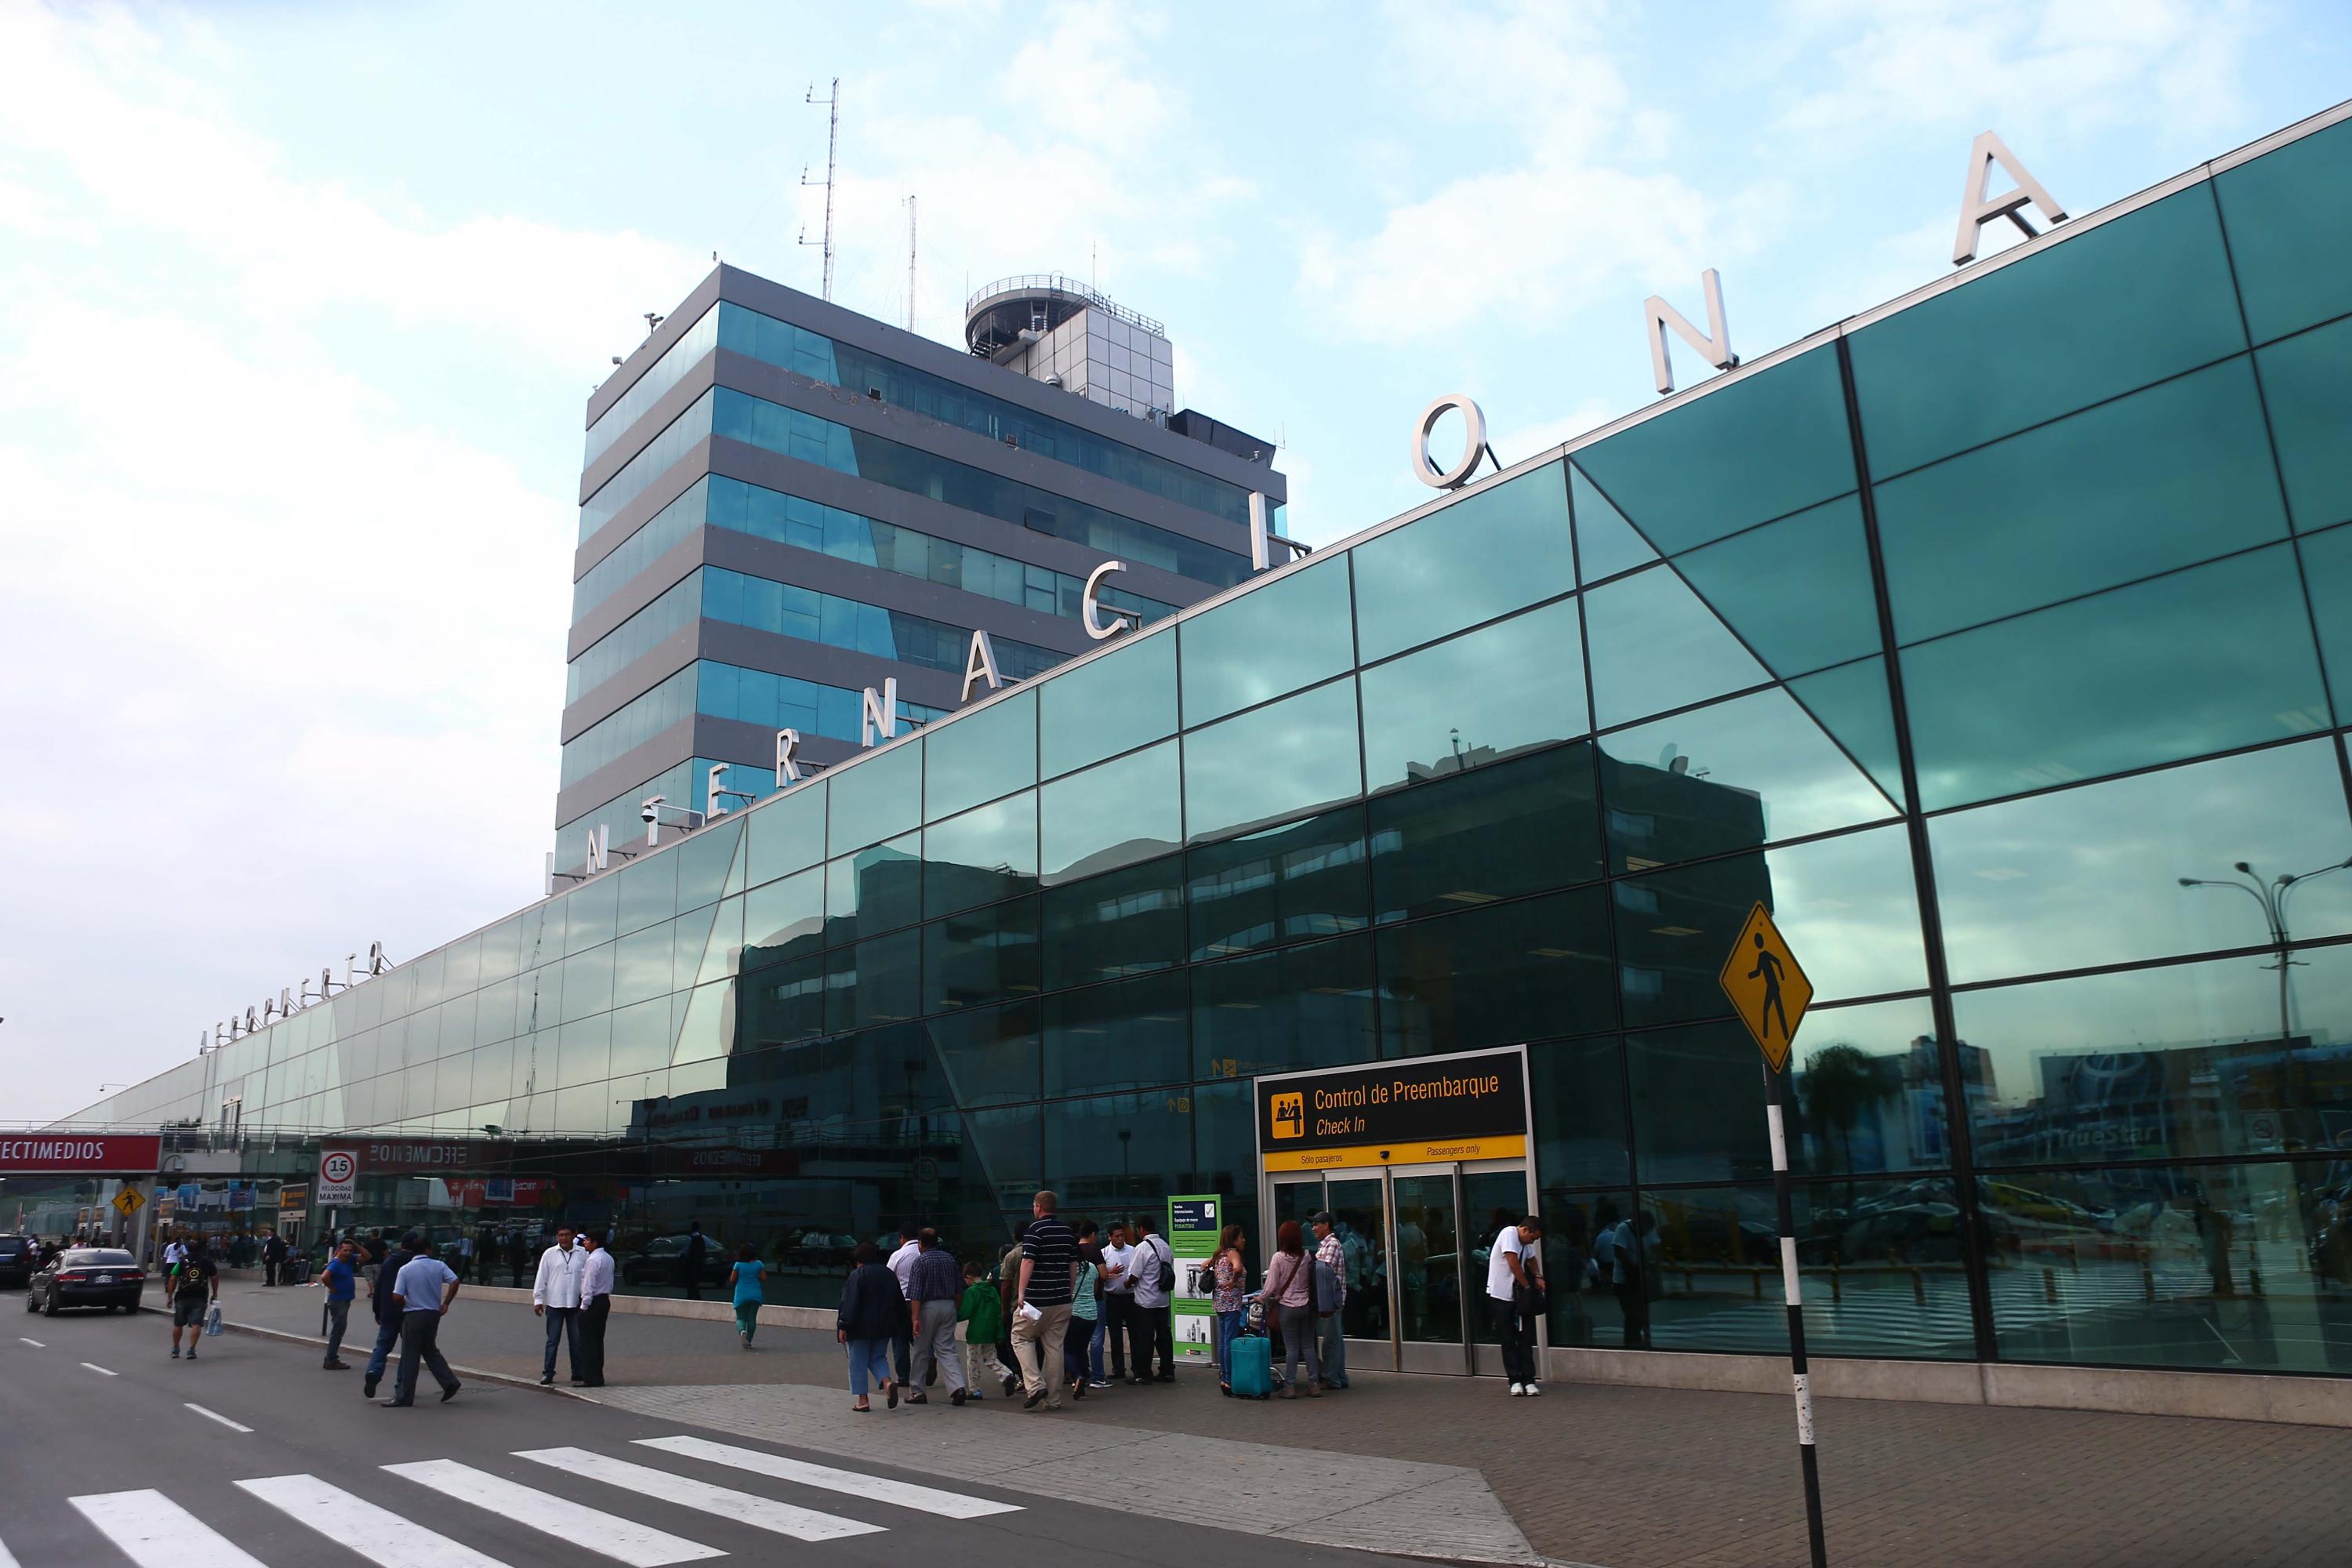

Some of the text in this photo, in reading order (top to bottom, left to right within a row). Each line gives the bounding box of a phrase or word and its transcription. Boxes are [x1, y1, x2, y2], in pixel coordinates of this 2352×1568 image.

[199, 941, 383, 1055] AEROPUERTO
[1315, 1075, 1499, 1110] Control de Preembarque
[1316, 1116, 1365, 1136] Check In
[0, 1141, 104, 1160] ECTIMEDIOS
[1301, 1154, 1343, 1164] Sólo pasajeros
[1426, 1143, 1481, 1156] Passengers only
[330, 1160, 348, 1172] 15
